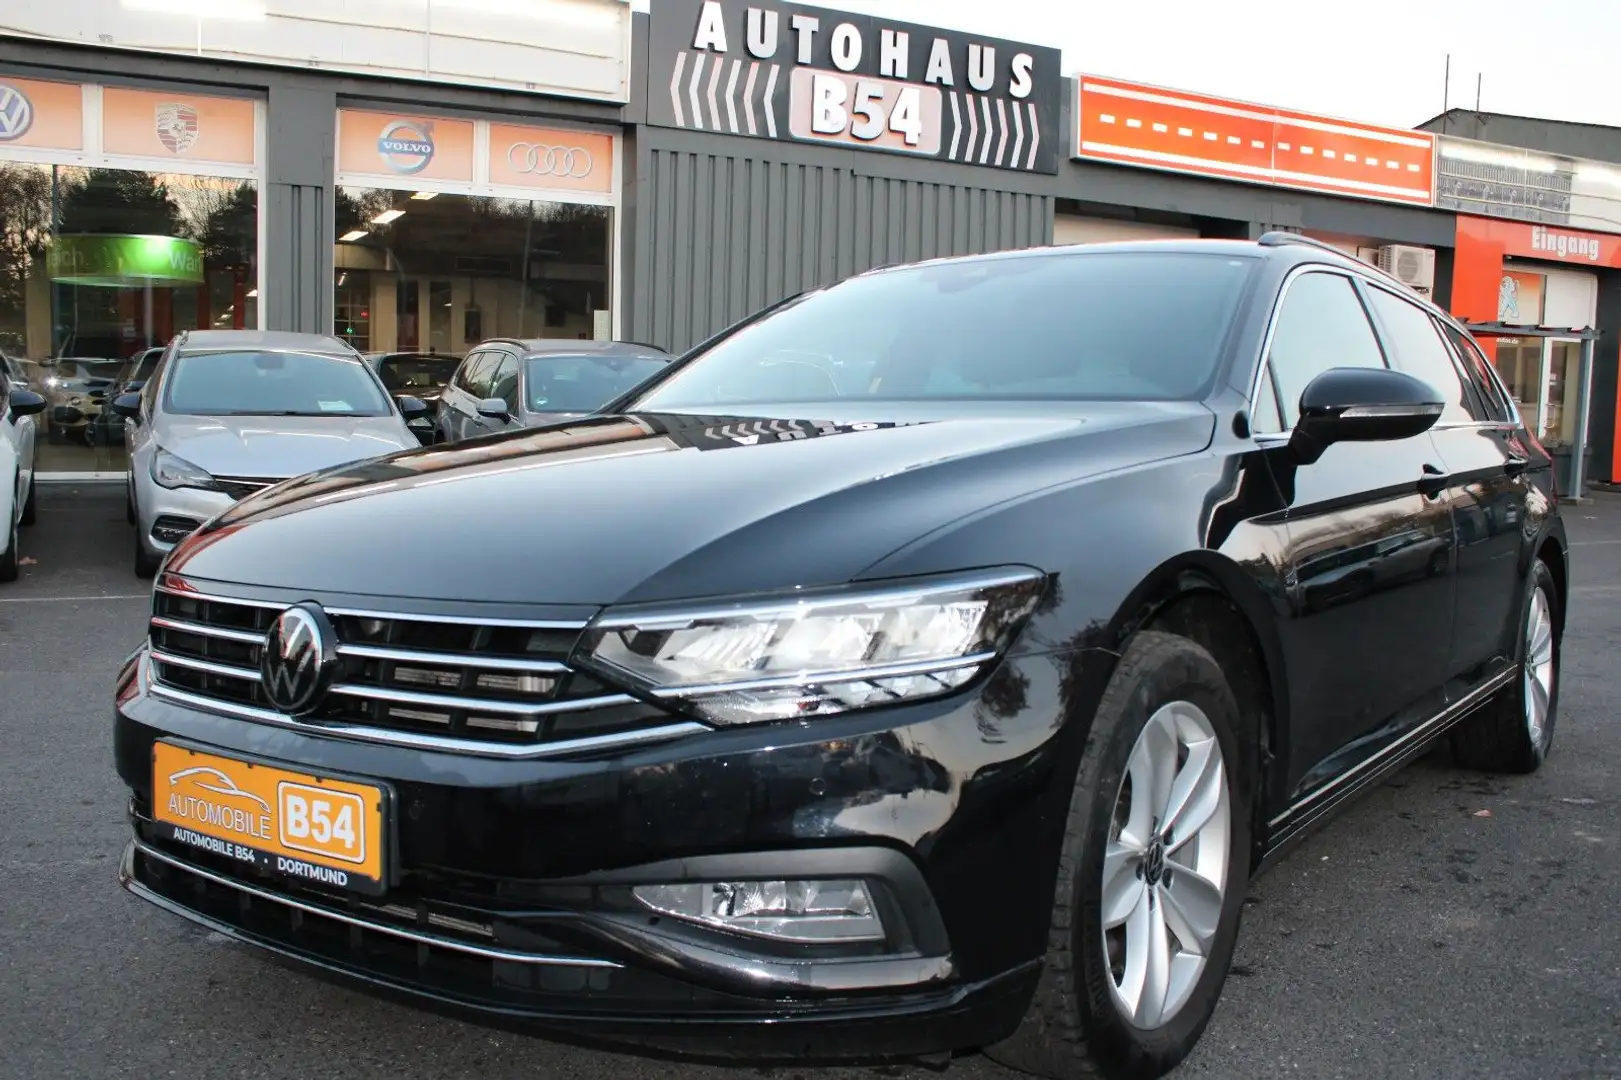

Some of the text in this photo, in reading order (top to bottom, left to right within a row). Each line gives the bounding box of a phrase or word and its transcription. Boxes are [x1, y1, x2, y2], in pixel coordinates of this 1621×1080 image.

[693, 1, 1034, 98] AUTOHAUS
[812, 75, 922, 145] B54
[383, 141, 431, 153] VOLVO
[1532, 226, 1599, 260] Eingang
[168, 792, 355, 849] AUTOMOBILE B54
[174, 827, 348, 886] AUTOMOBILE B54 DORTMUND
